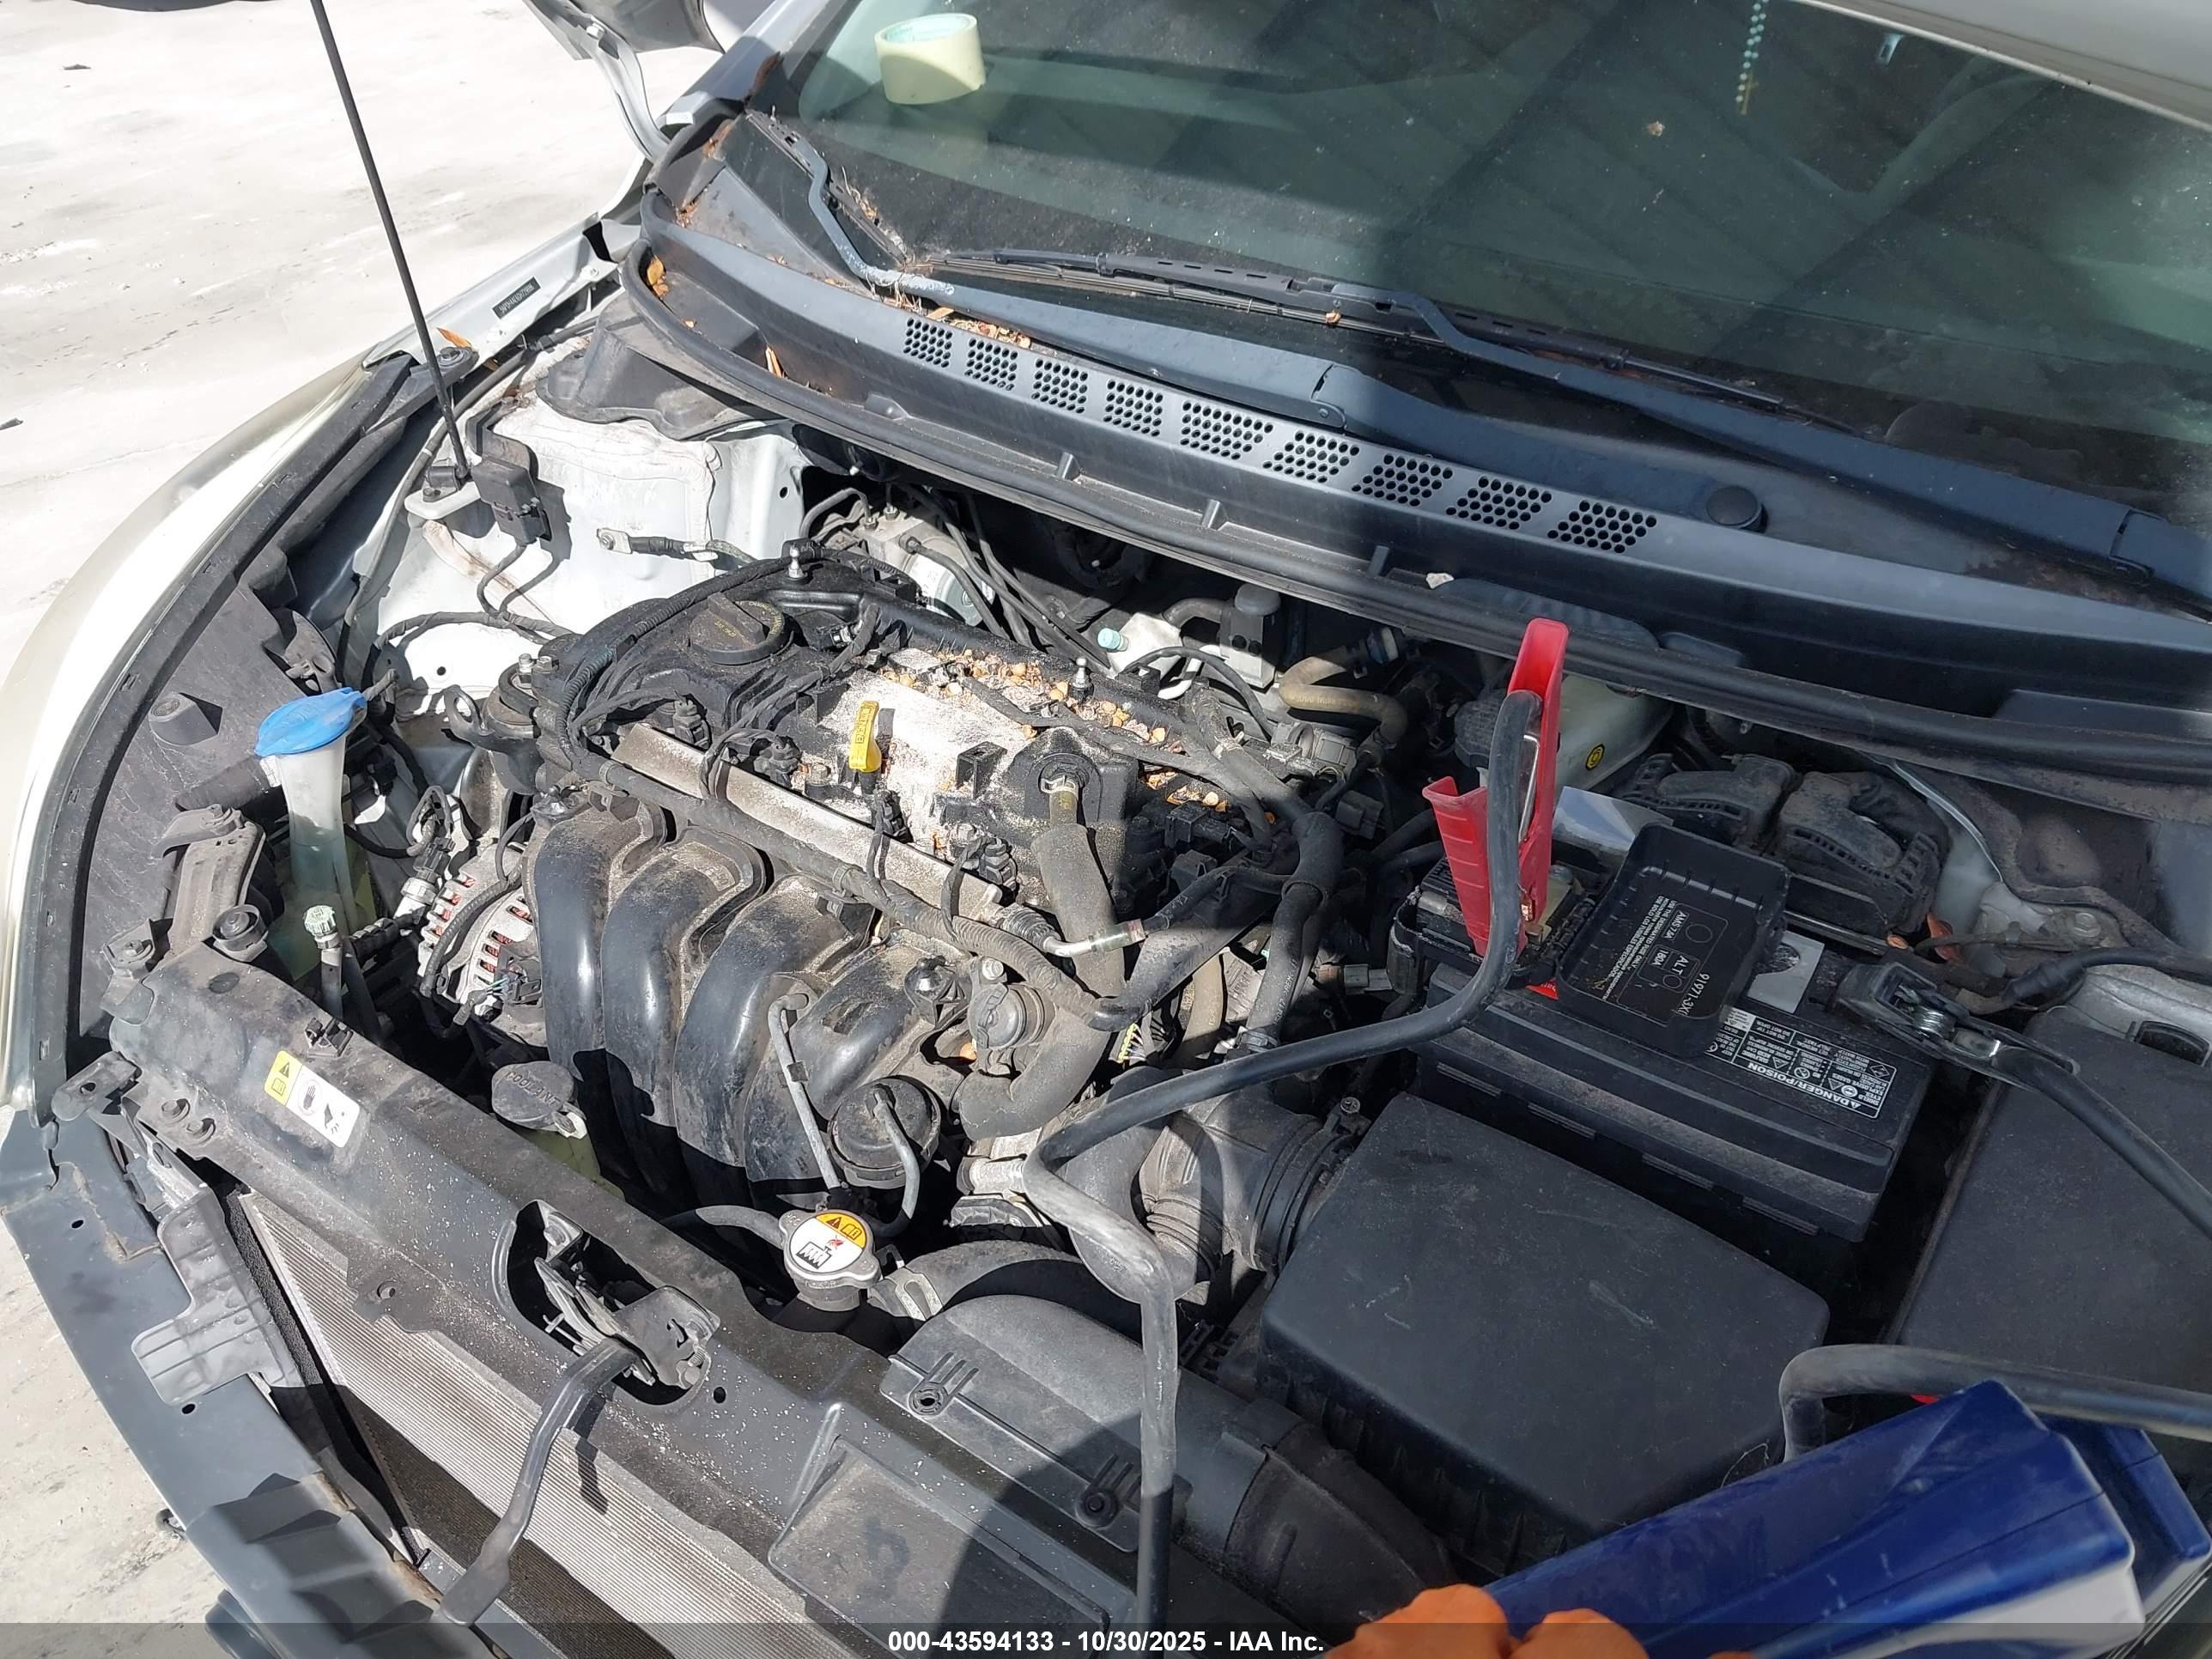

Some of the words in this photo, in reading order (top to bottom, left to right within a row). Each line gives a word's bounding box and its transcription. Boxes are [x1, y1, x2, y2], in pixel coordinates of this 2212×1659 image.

[1670, 910, 1687, 927] AMS
[1644, 916, 1666, 945] DESIGNATED
[1650, 948, 1668, 967] 180A
[1669, 955, 1691, 975] ALT
[504, 1070, 562, 1107] COOLANT
[1747, 1061, 1850, 1105] DANGER/POISON
[1857, 1093, 1879, 1105] SHIELD
